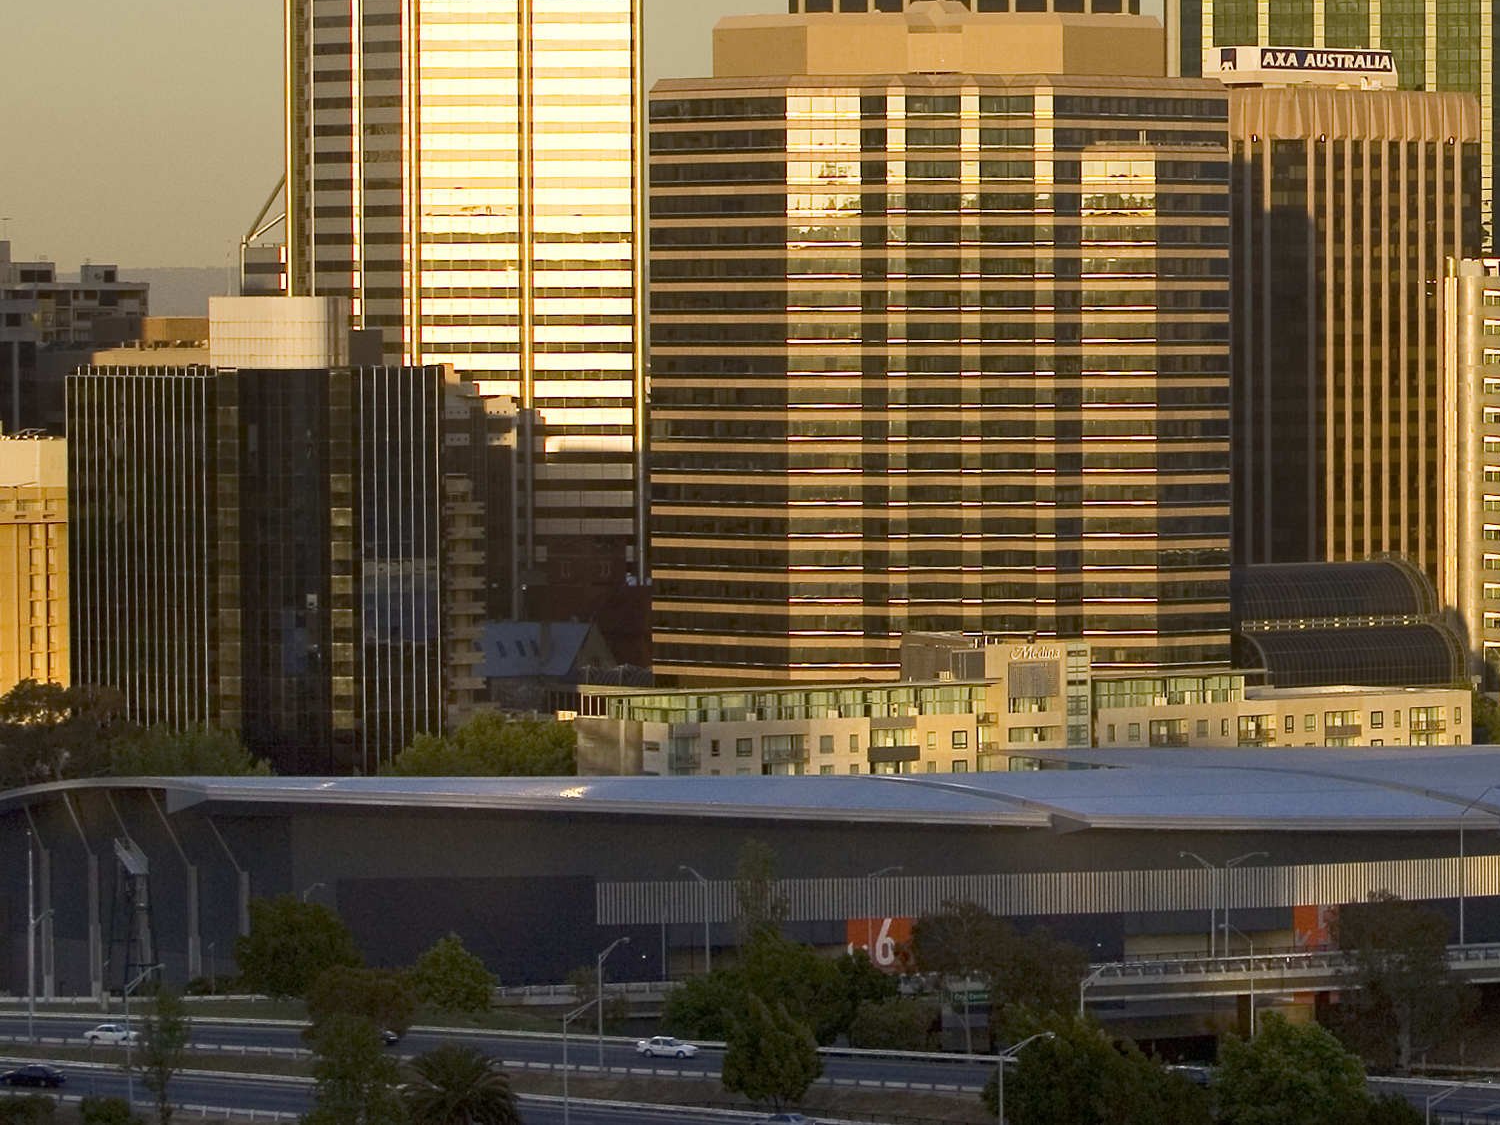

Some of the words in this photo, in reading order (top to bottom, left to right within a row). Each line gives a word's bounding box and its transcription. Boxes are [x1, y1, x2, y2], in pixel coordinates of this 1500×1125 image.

[1262, 52, 1298, 67] AXA
[1303, 52, 1392, 69] AUSTRALIA
[1010, 645, 1061, 660] Medina
[875, 917, 896, 966] 6
